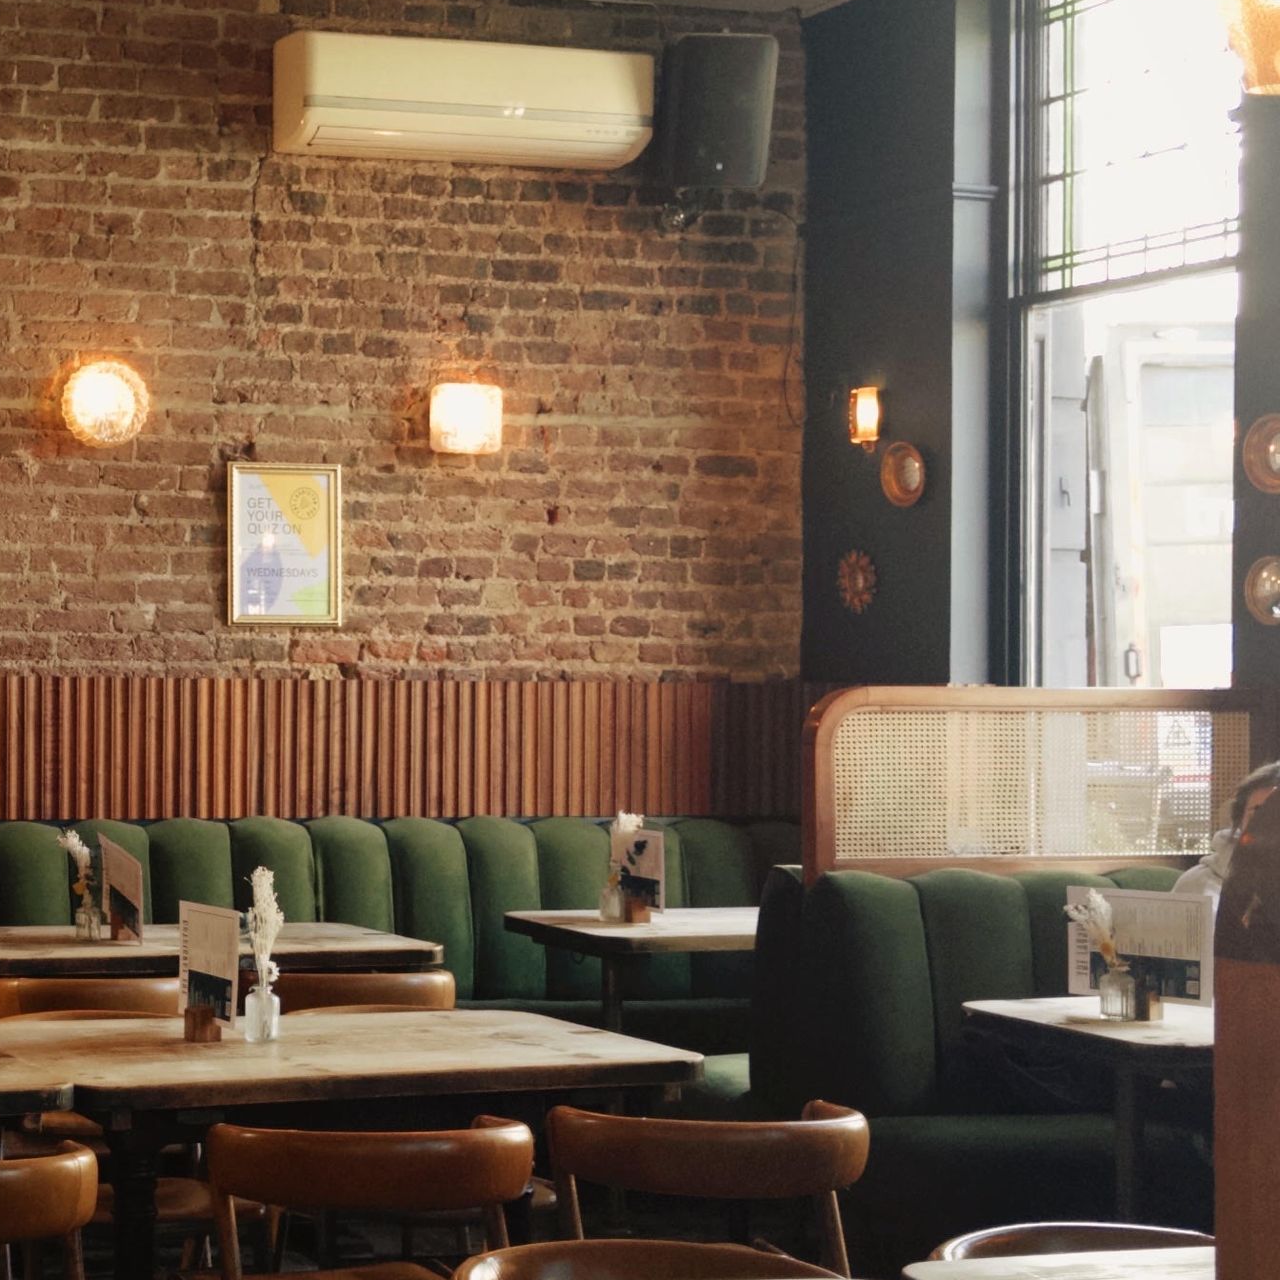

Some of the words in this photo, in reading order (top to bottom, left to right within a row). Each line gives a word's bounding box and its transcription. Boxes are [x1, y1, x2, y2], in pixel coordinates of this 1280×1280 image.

[247, 497, 272, 509] GET
[247, 511, 283, 522] YOUR
[282, 523, 302, 535] ON
[247, 568, 319, 578] WEDNESDAYS
